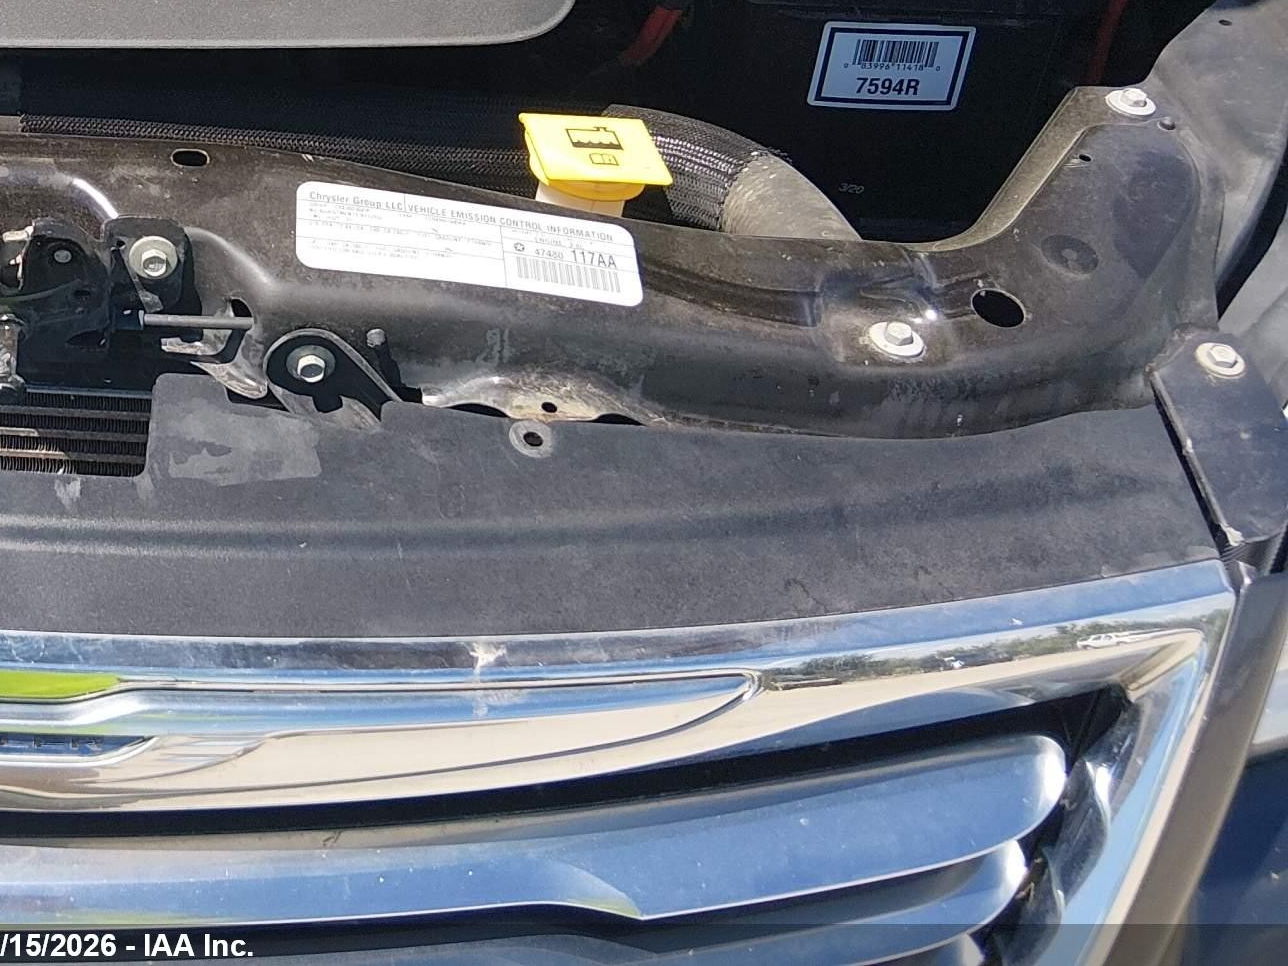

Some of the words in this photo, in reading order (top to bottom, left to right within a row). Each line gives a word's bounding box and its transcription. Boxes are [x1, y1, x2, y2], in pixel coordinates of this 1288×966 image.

[855, 77, 920, 96] 7594R
[309, 191, 349, 203] Chrysler
[352, 196, 381, 209] Group
[385, 201, 403, 211] LLC
[408, 204, 447, 216] VEHICLE
[450, 210, 496, 223] EMISSION
[500, 217, 543, 231] CONTROL
[546, 225, 613, 242] INFORMATION
[572, 249, 617, 268] 117AA
